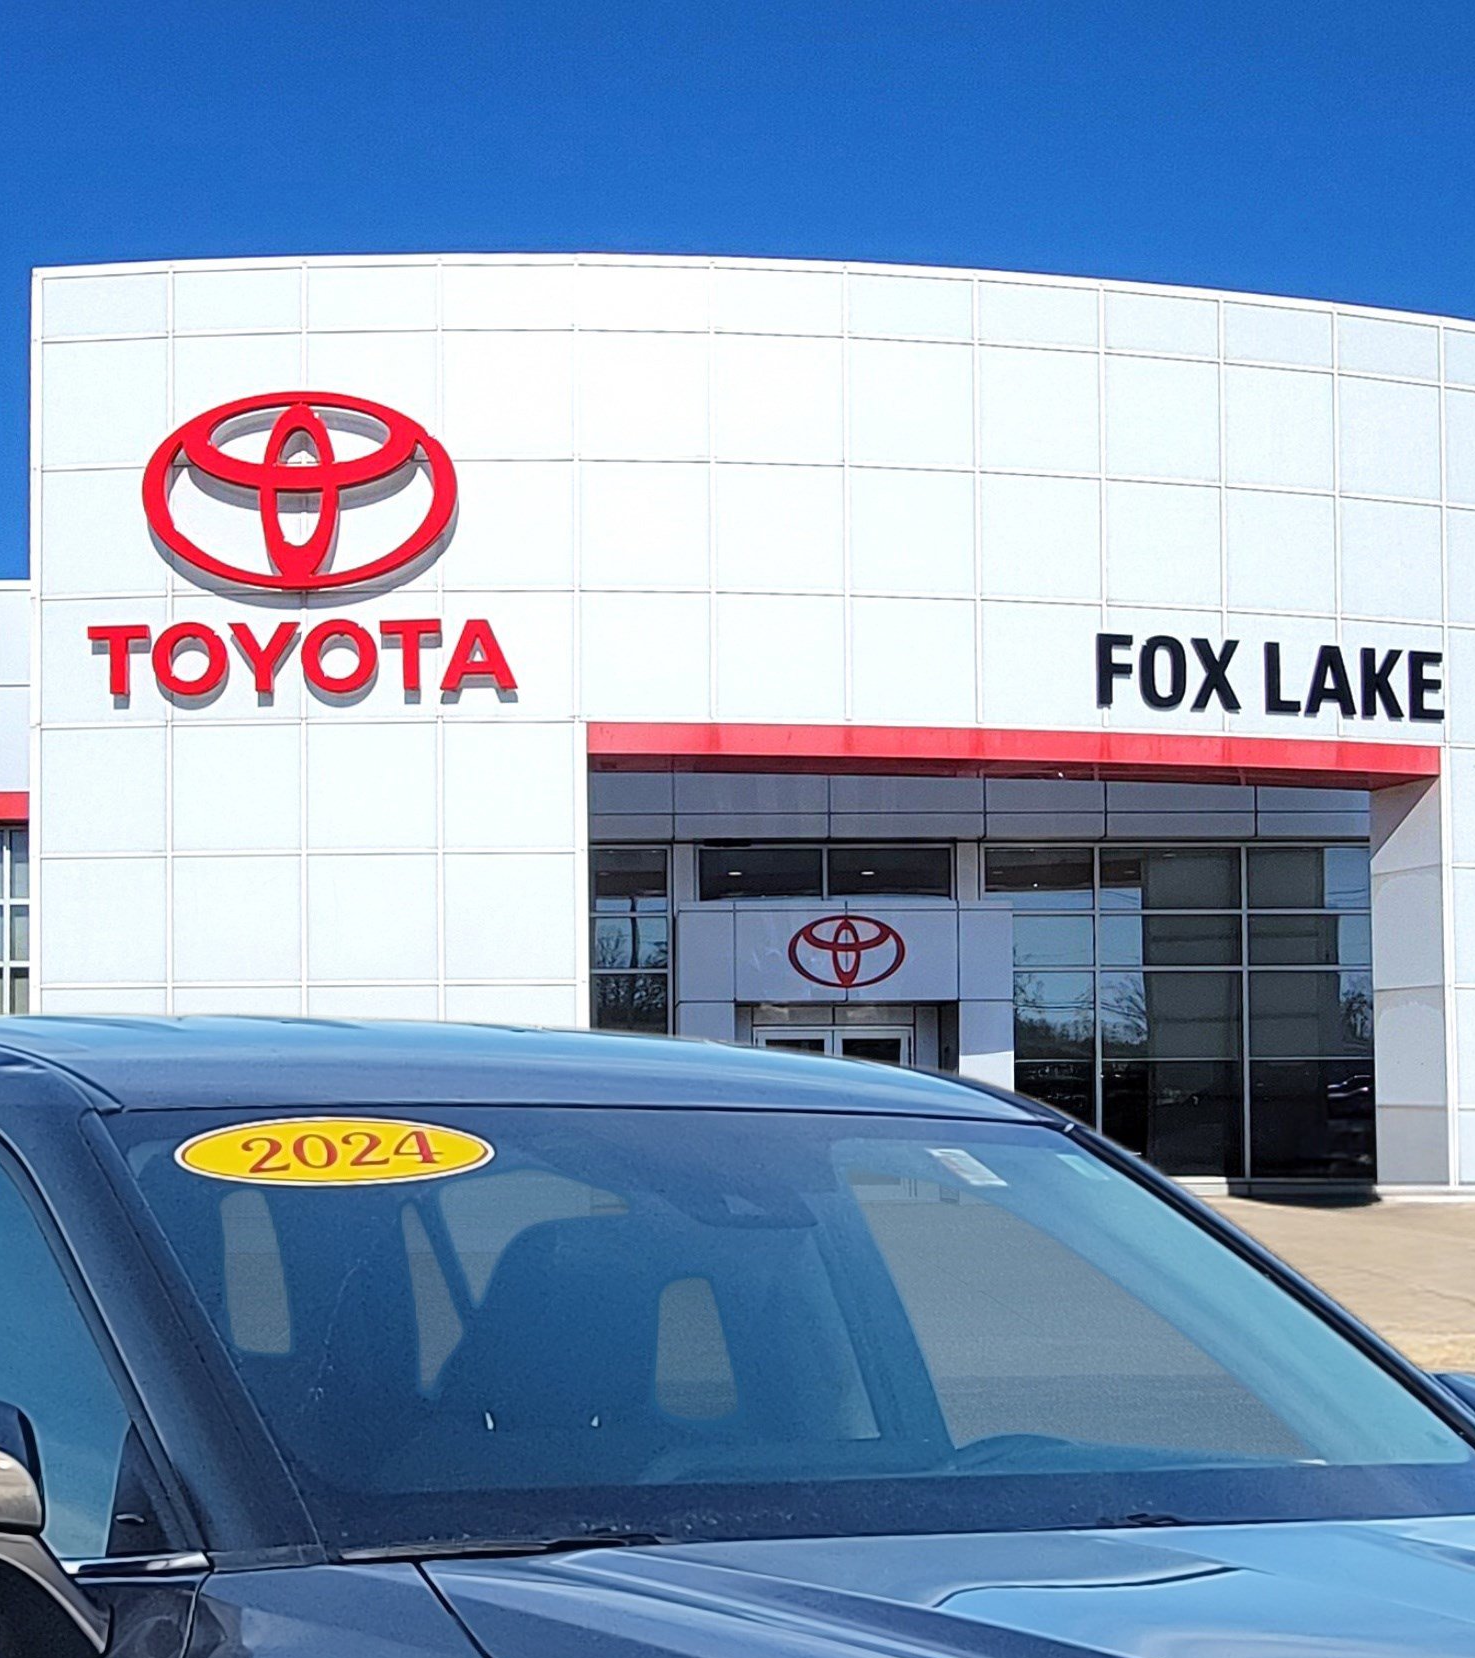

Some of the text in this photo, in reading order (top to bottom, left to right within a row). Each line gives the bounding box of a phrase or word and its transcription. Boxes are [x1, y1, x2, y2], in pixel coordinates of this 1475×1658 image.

[87, 617, 519, 699] TOYOTA
[1096, 632, 1446, 722] FOX LAKE
[240, 1130, 445, 1174] 2024
